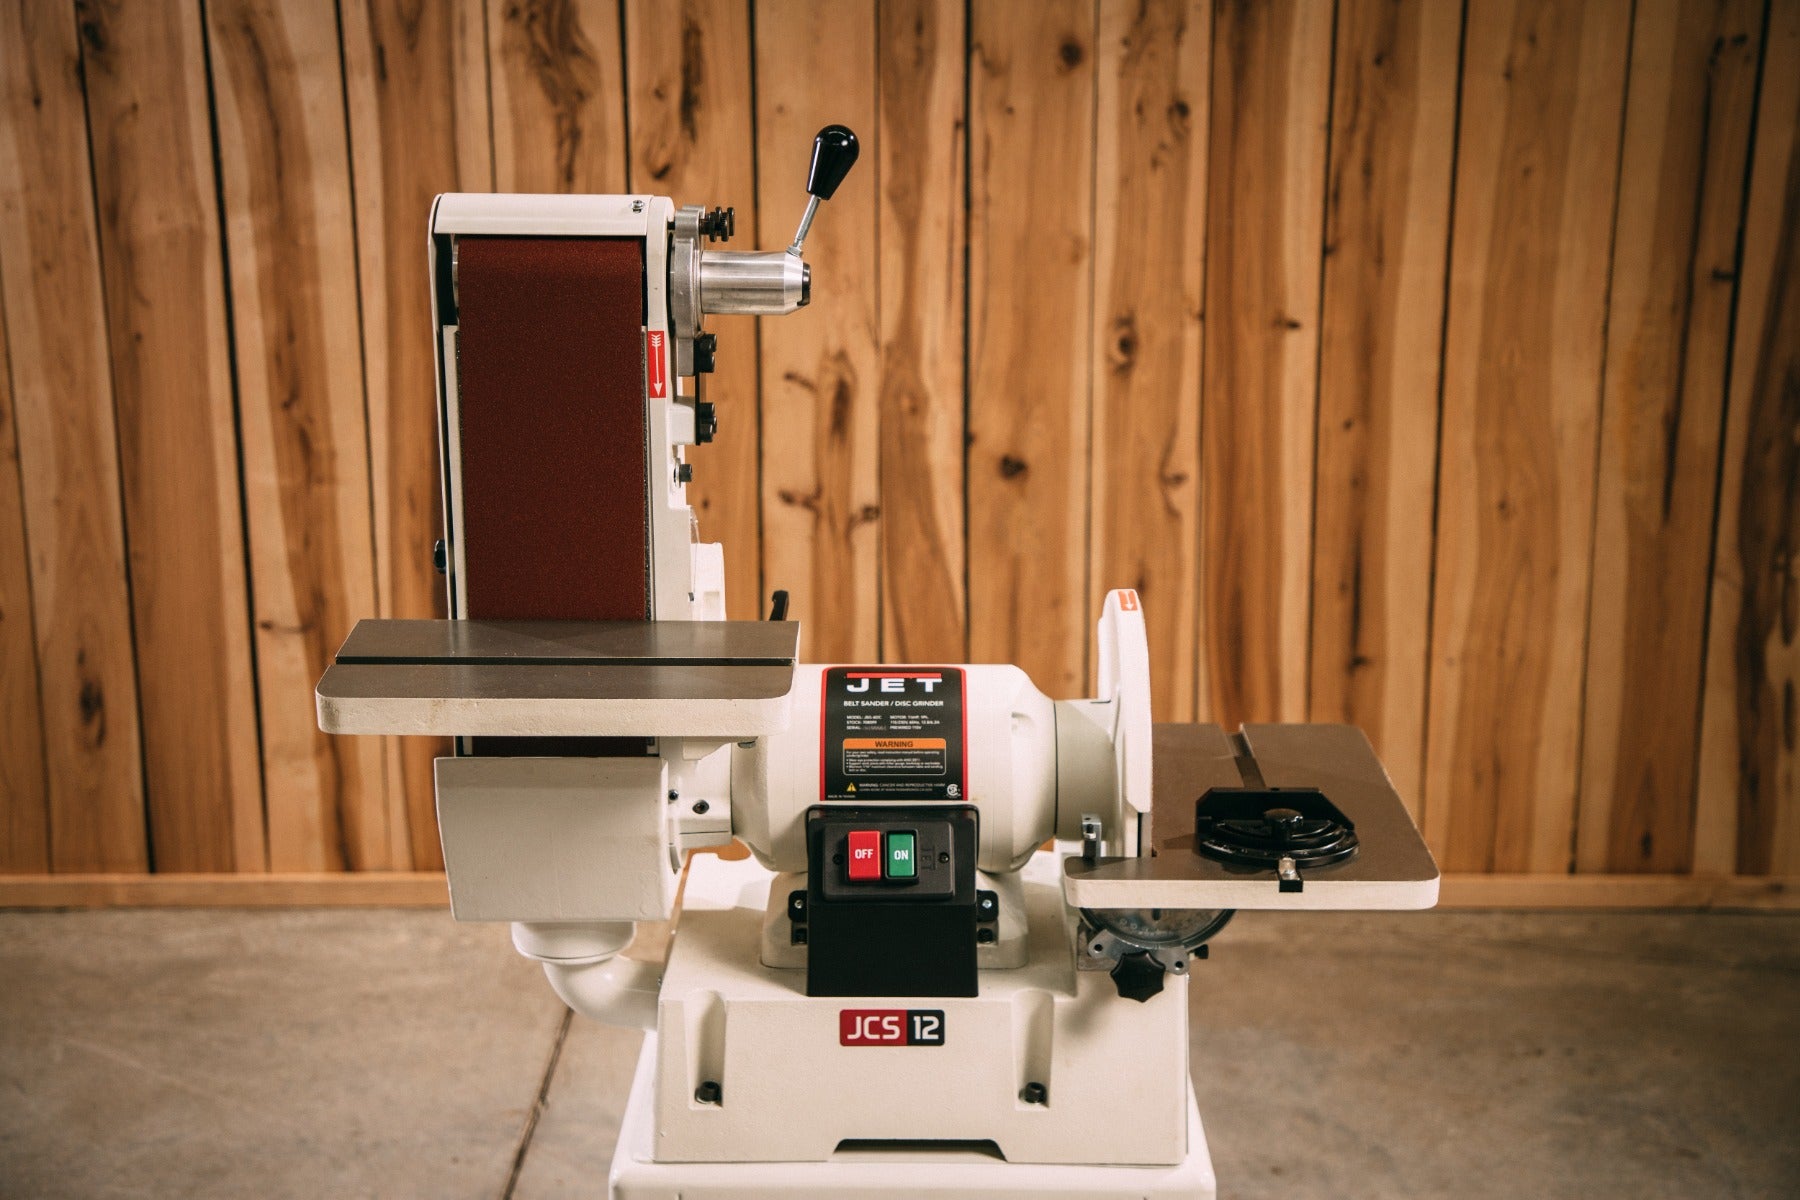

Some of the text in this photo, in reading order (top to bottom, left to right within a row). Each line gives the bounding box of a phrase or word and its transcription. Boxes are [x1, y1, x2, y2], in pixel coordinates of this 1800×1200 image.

[846, 678, 942, 692] JET
[874, 740, 914, 748] WARNING
[855, 848, 874, 859] OFF
[894, 849, 909, 860] ON
[847, 1016, 939, 1039] JCS 12
